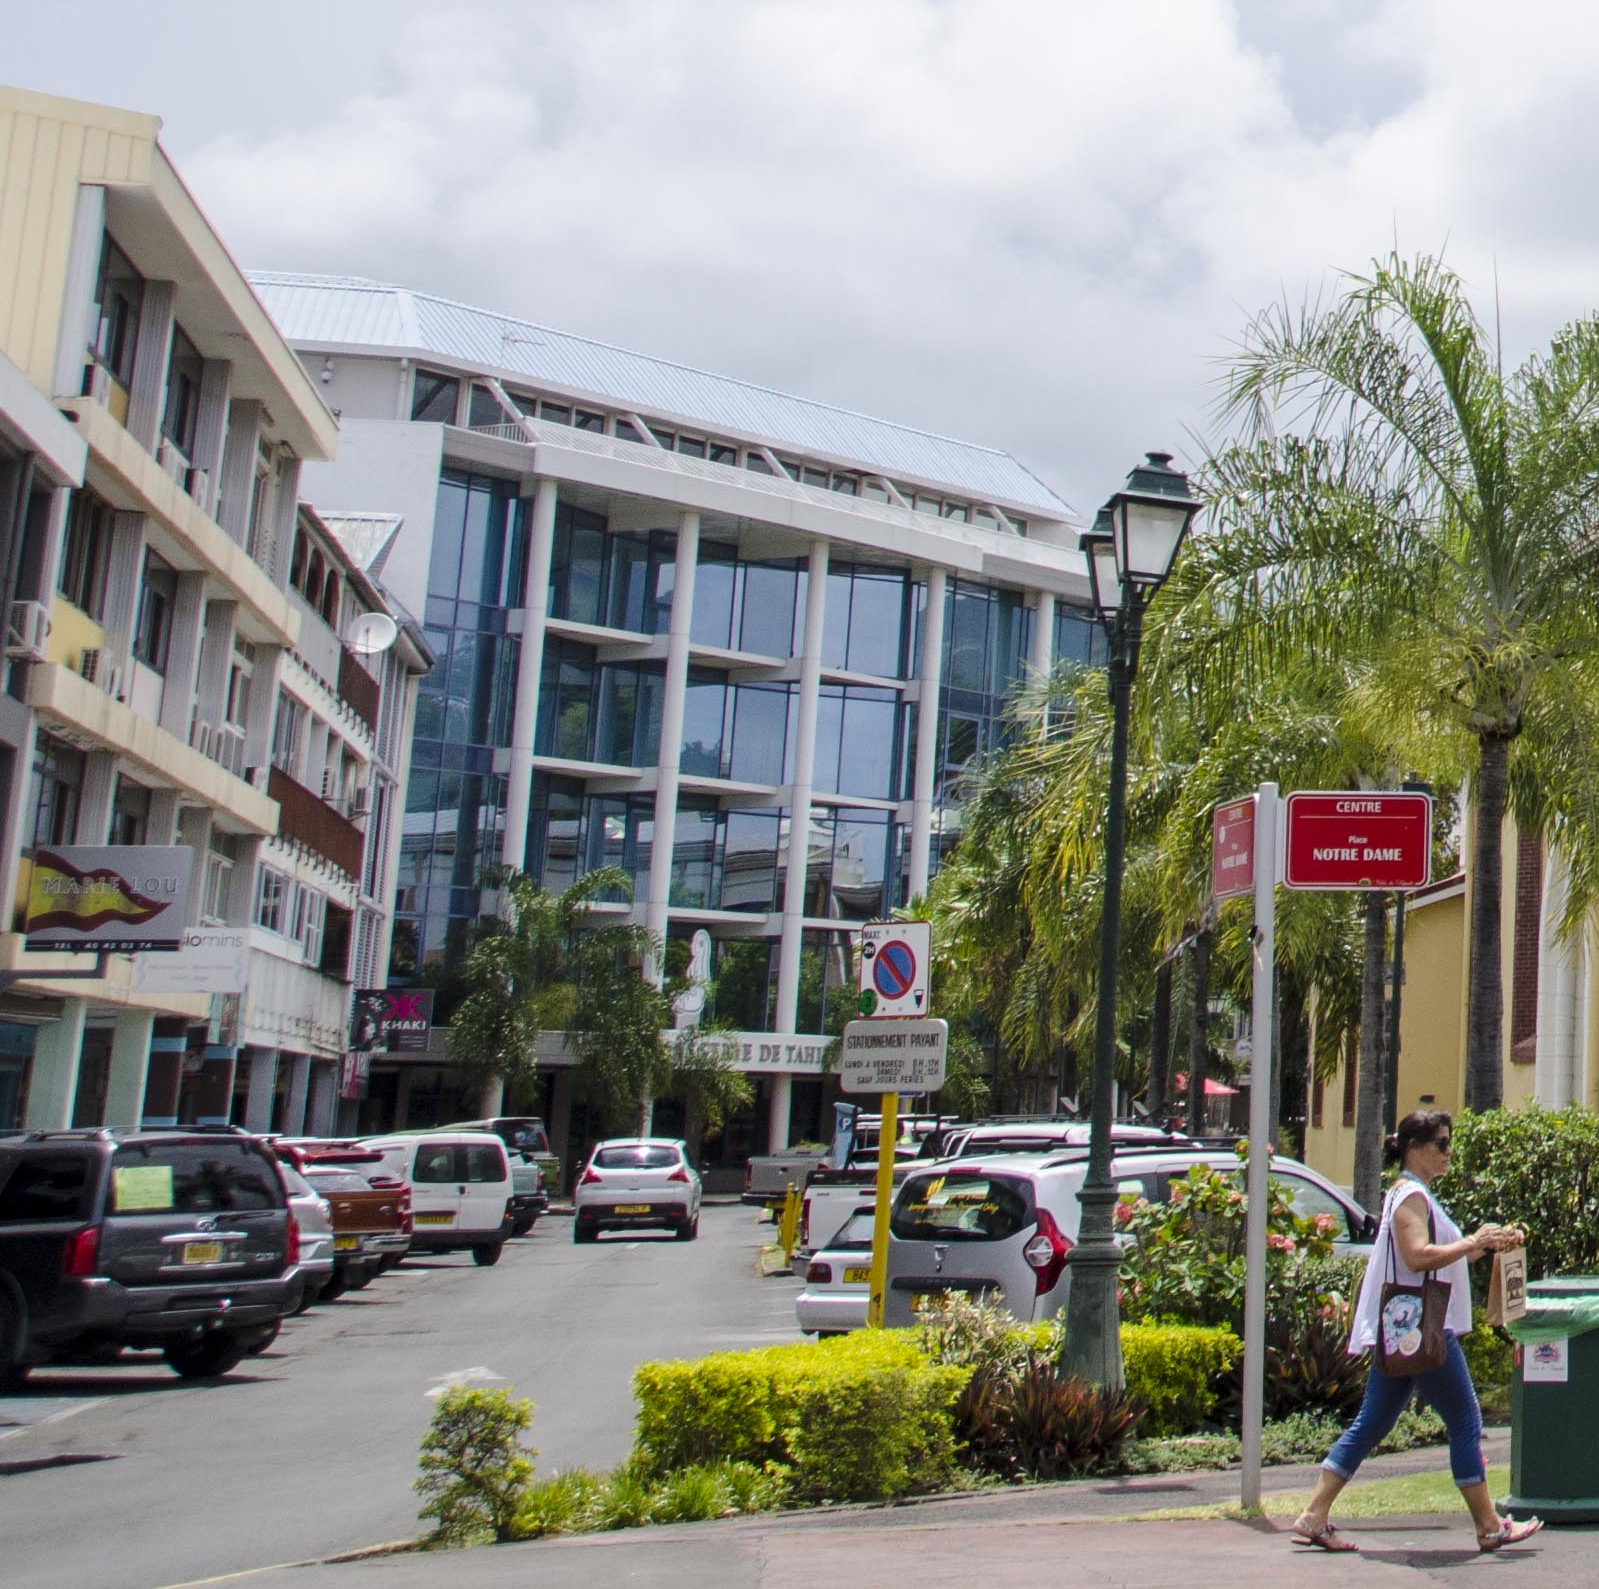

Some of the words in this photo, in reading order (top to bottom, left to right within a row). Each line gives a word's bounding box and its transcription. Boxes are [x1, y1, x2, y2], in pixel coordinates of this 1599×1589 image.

[1336, 801, 1382, 813] CENTRE
[1348, 835, 1367, 844] Place
[1313, 848, 1359, 861] NOTRE
[1363, 848, 1403, 861] DAME
[42, 876, 122, 894] MARIE
[130, 876, 178, 894] LOU
[382, 1020, 427, 1030] KHAKI
[847, 1034, 907, 1049] STATIONNEMENT
[910, 1033, 939, 1047] PAYANT
[759, 1044, 781, 1063] DE
